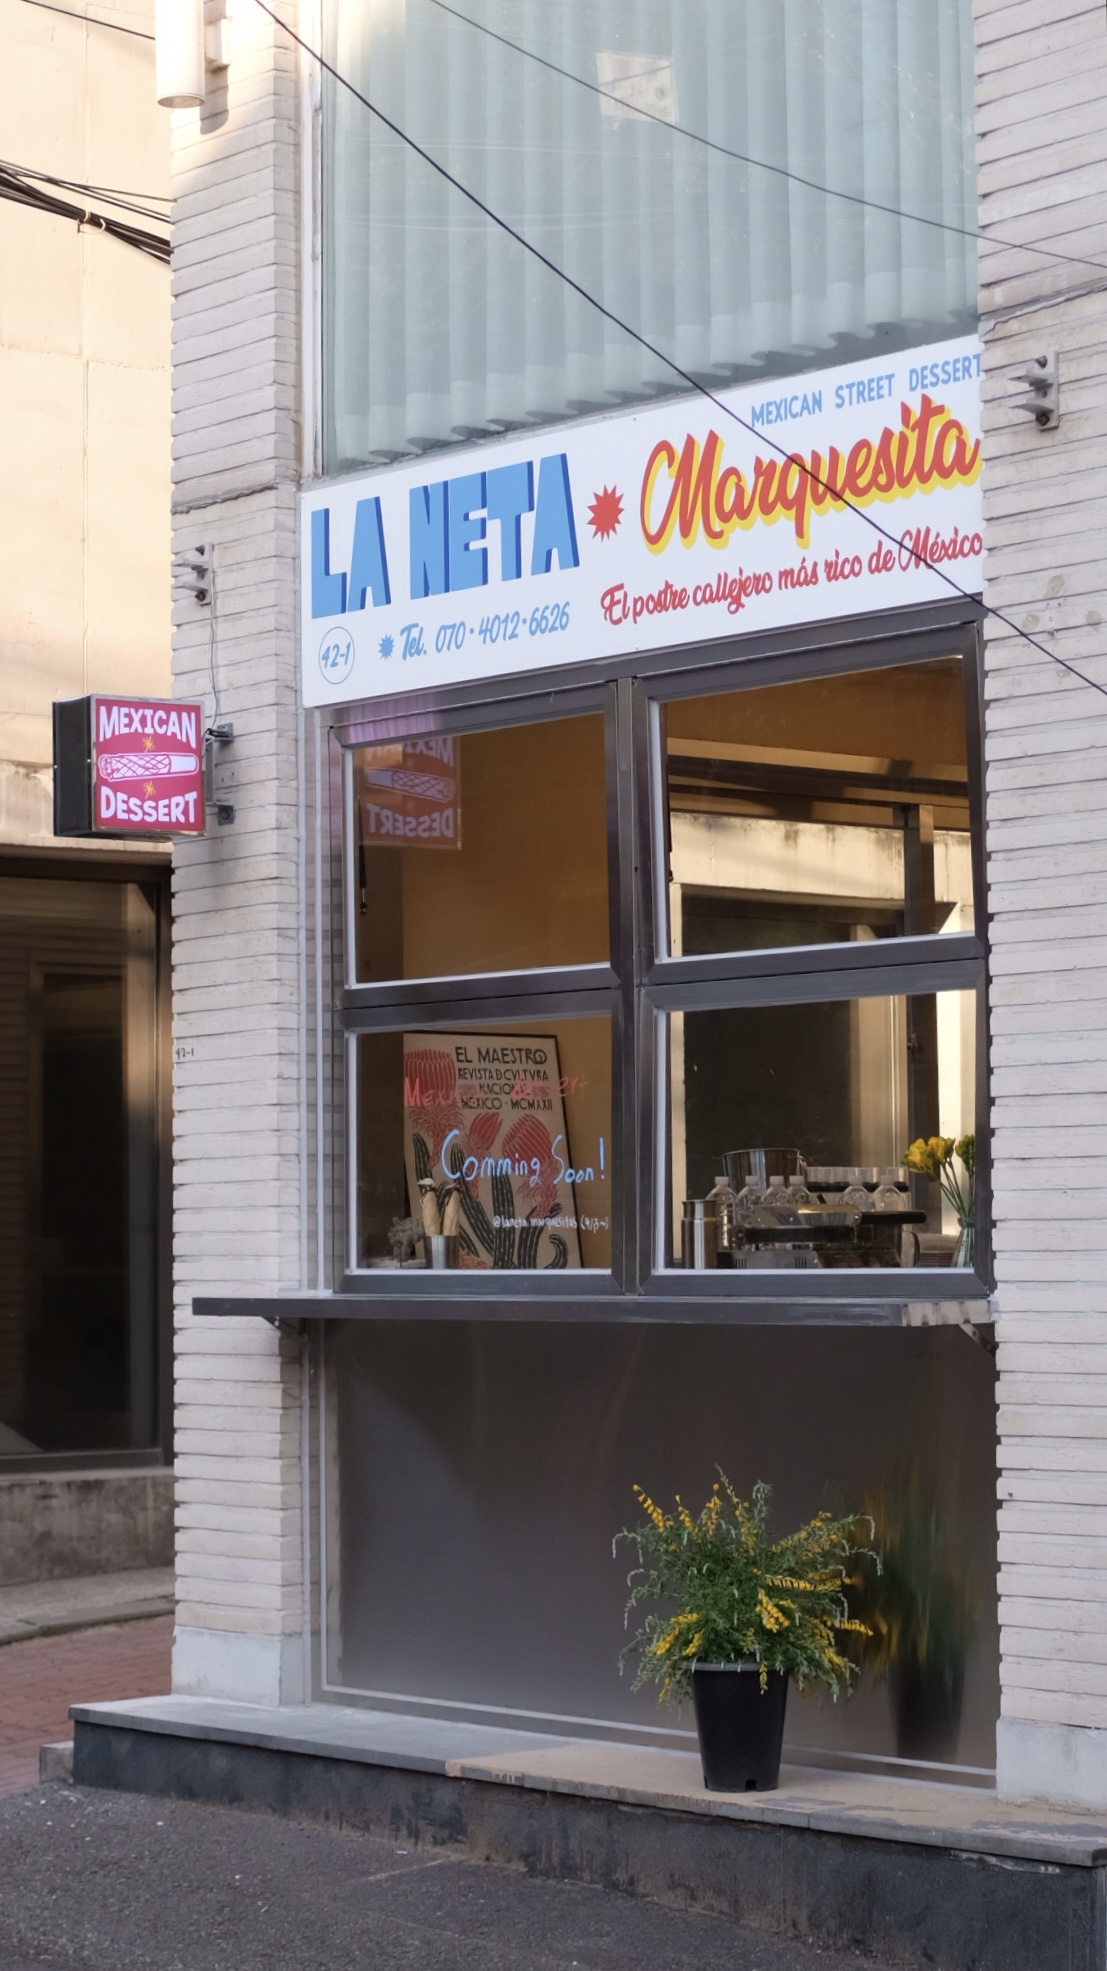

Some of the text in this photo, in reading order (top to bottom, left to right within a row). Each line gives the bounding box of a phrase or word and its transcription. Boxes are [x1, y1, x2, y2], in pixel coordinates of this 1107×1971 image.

[751, 353, 981, 427] MEXICAN STREET DESSERT
[640, 394, 982, 554] Marquesita
[311, 453, 580, 620] LA NETA
[601, 526, 983, 625] El postre callejero más rico de México
[321, 642, 351, 669] 42-1
[400, 623, 427, 660] Tel.
[99, 705, 197, 750] MEXICAN
[100, 785, 197, 823] DESSERT
[175, 1047, 194, 1061] 42-1
[455, 1046, 547, 1065] EL MAESTRO
[457, 1067, 494, 1080] REVISTA
[461, 1096, 502, 1111] MEXICO
[441, 1129, 605, 1188] Comming Soon!
